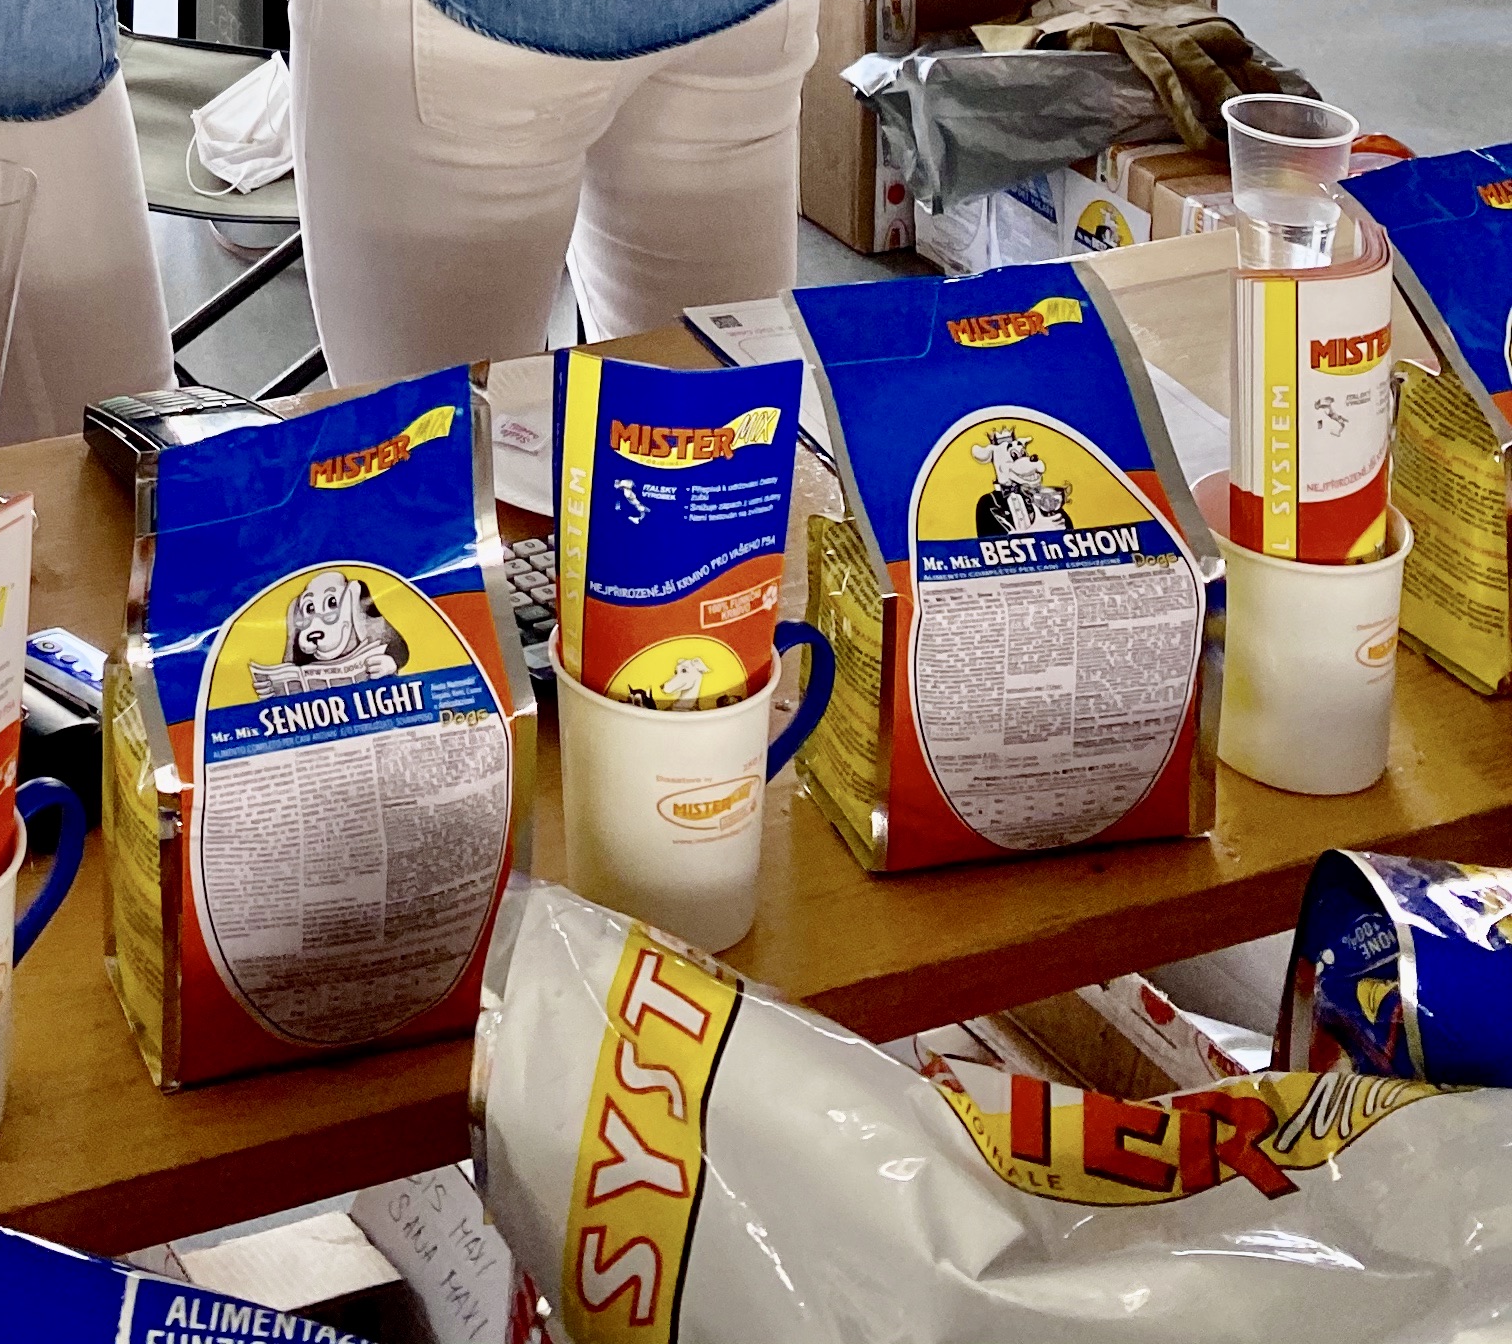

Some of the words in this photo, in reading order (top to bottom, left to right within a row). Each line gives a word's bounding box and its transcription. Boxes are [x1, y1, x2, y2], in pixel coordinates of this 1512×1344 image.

[947, 310, 1049, 344] MISTER
[309, 433, 411, 489] MISTER
[610, 419, 735, 460] MISTER
[1271, 385, 1291, 519] SYSTEM
[561, 466, 588, 608] SYSTEM
[922, 556, 948, 571] Mr.
[949, 555, 980, 569] Mix
[979, 538, 1037, 566] BEST
[1040, 540, 1064, 560] in
[1063, 527, 1140, 558] SHOW
[1131, 551, 1179, 569] Dogs
[211, 731, 234, 744] Mr.
[236, 726, 261, 739] Mix
[259, 695, 350, 737] SENIOR
[352, 681, 424, 720] LIGHT
[438, 707, 490, 728] Dogs
